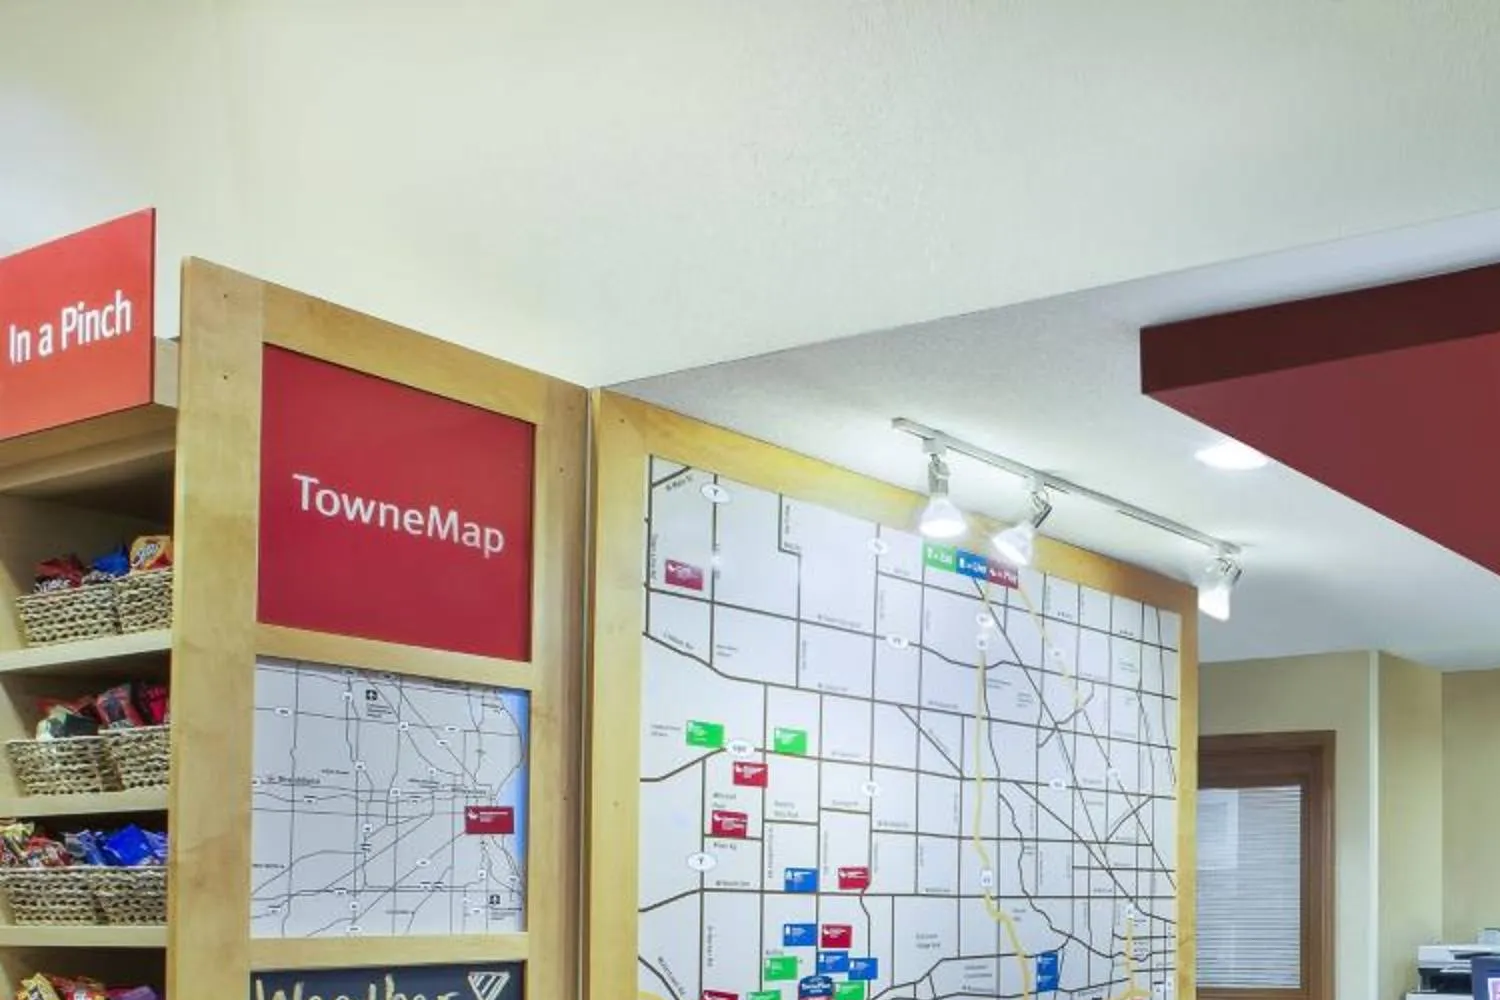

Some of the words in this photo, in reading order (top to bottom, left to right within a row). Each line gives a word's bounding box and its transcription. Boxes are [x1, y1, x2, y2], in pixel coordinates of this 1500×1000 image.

[9, 322, 31, 365] In
[37, 322, 53, 358] a
[61, 289, 132, 349] Pinch
[292, 473, 505, 559] TowneMap
